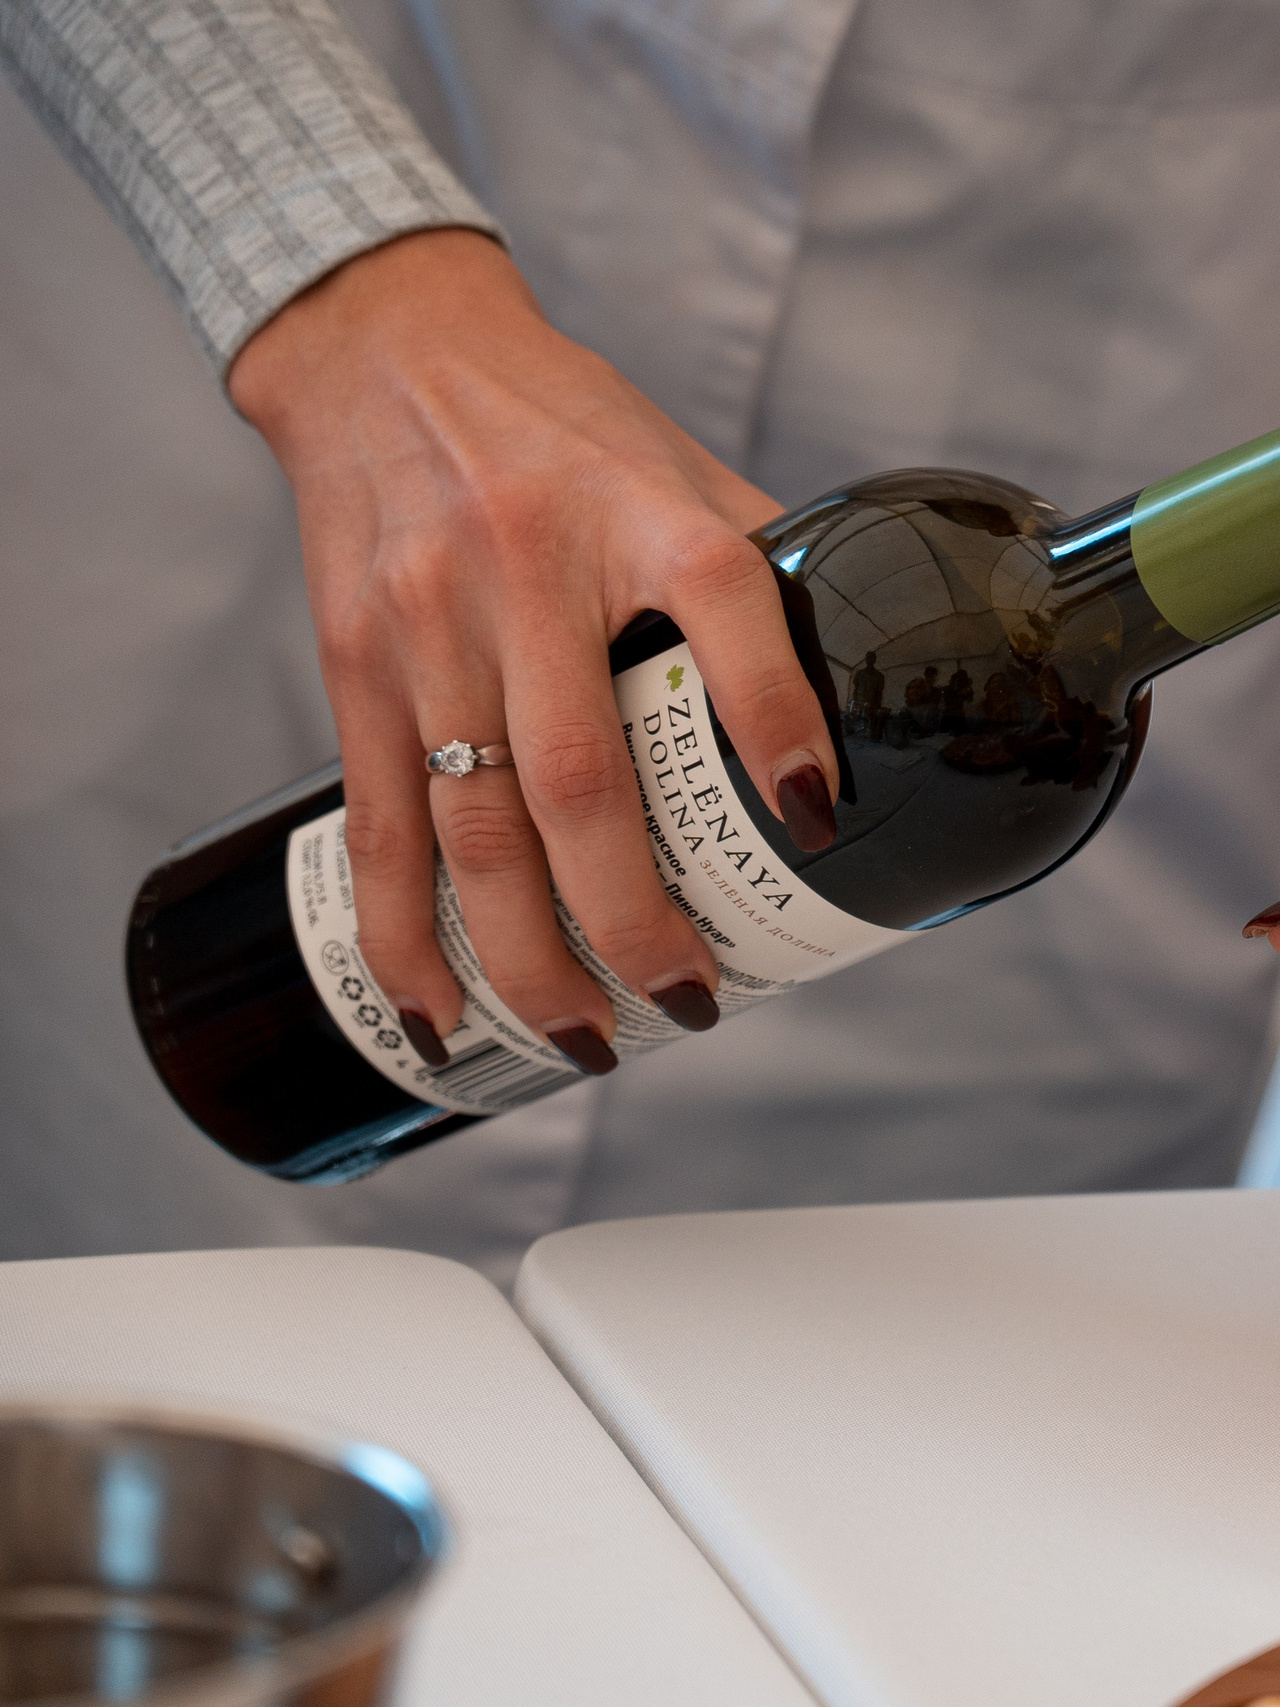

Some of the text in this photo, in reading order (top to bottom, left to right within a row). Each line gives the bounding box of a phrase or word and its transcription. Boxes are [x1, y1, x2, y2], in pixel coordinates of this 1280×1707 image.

[643, 709, 705, 855] DOLINA
[667, 697, 794, 912] ZELËNAYA
[645, 814, 687, 877] красное
[665, 882, 699, 918] Пино
[695, 916, 736, 949] Нуар»
[699, 859, 837, 958] ЗЕЛЁНАЯ ДОЛИНА
